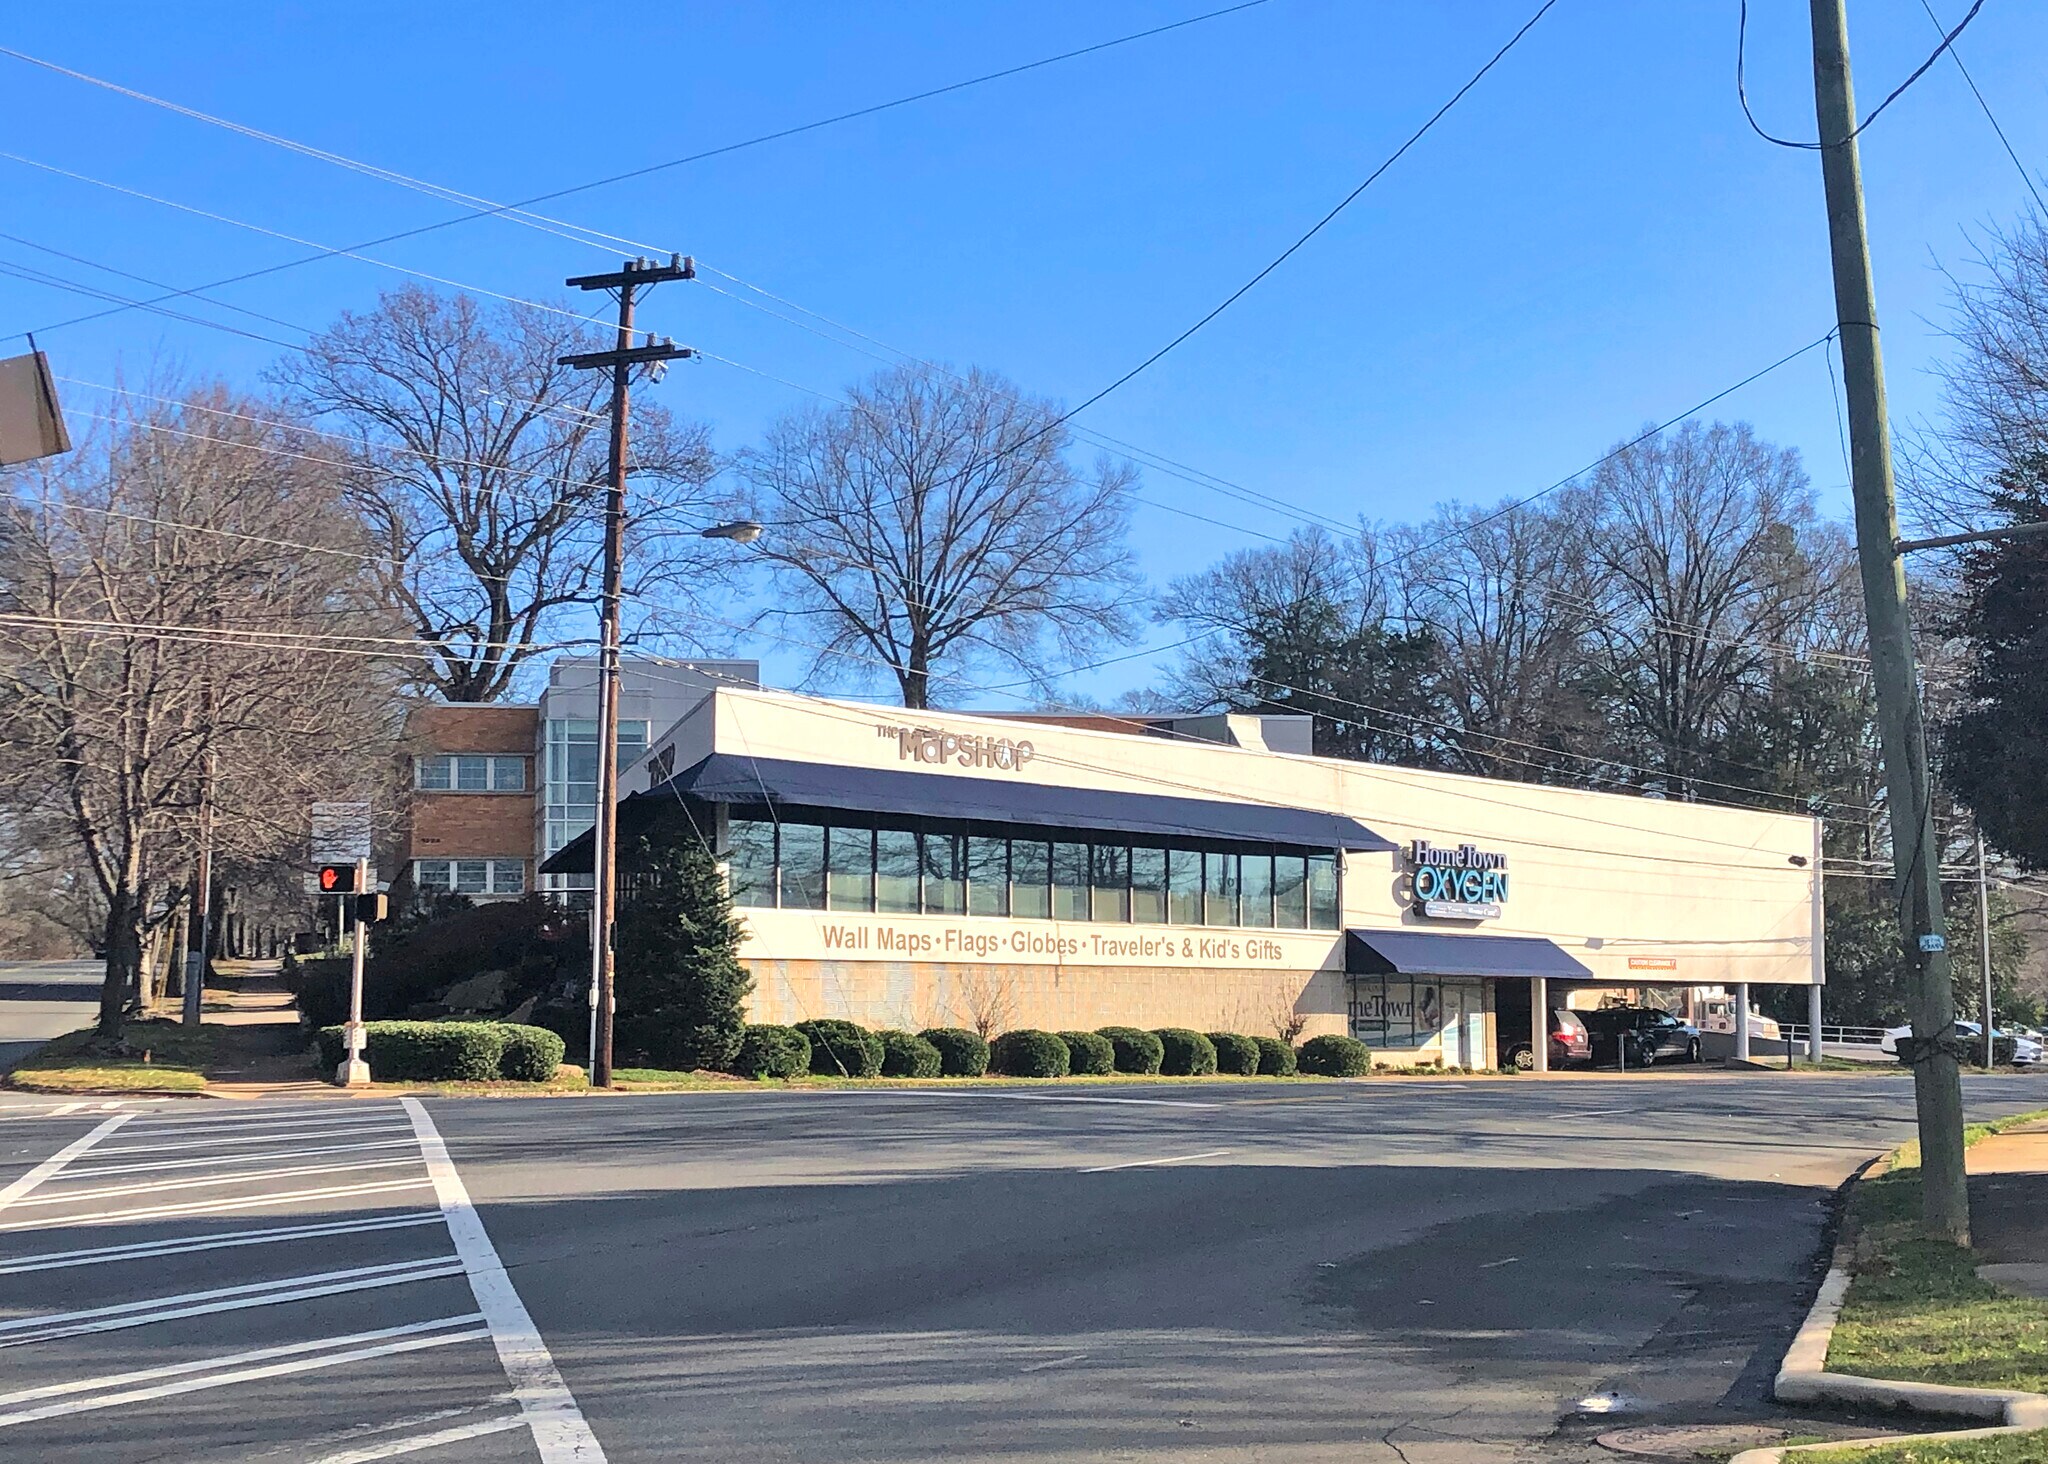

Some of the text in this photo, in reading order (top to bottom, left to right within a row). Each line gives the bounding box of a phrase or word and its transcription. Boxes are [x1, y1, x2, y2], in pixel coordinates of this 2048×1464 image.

[1411, 838, 1509, 870] HomeTown
[1414, 865, 1510, 903] OXYGEN
[822, 925, 1283, 961] Wall Maps Flags Globes Traveler's & Kid's Gifts
